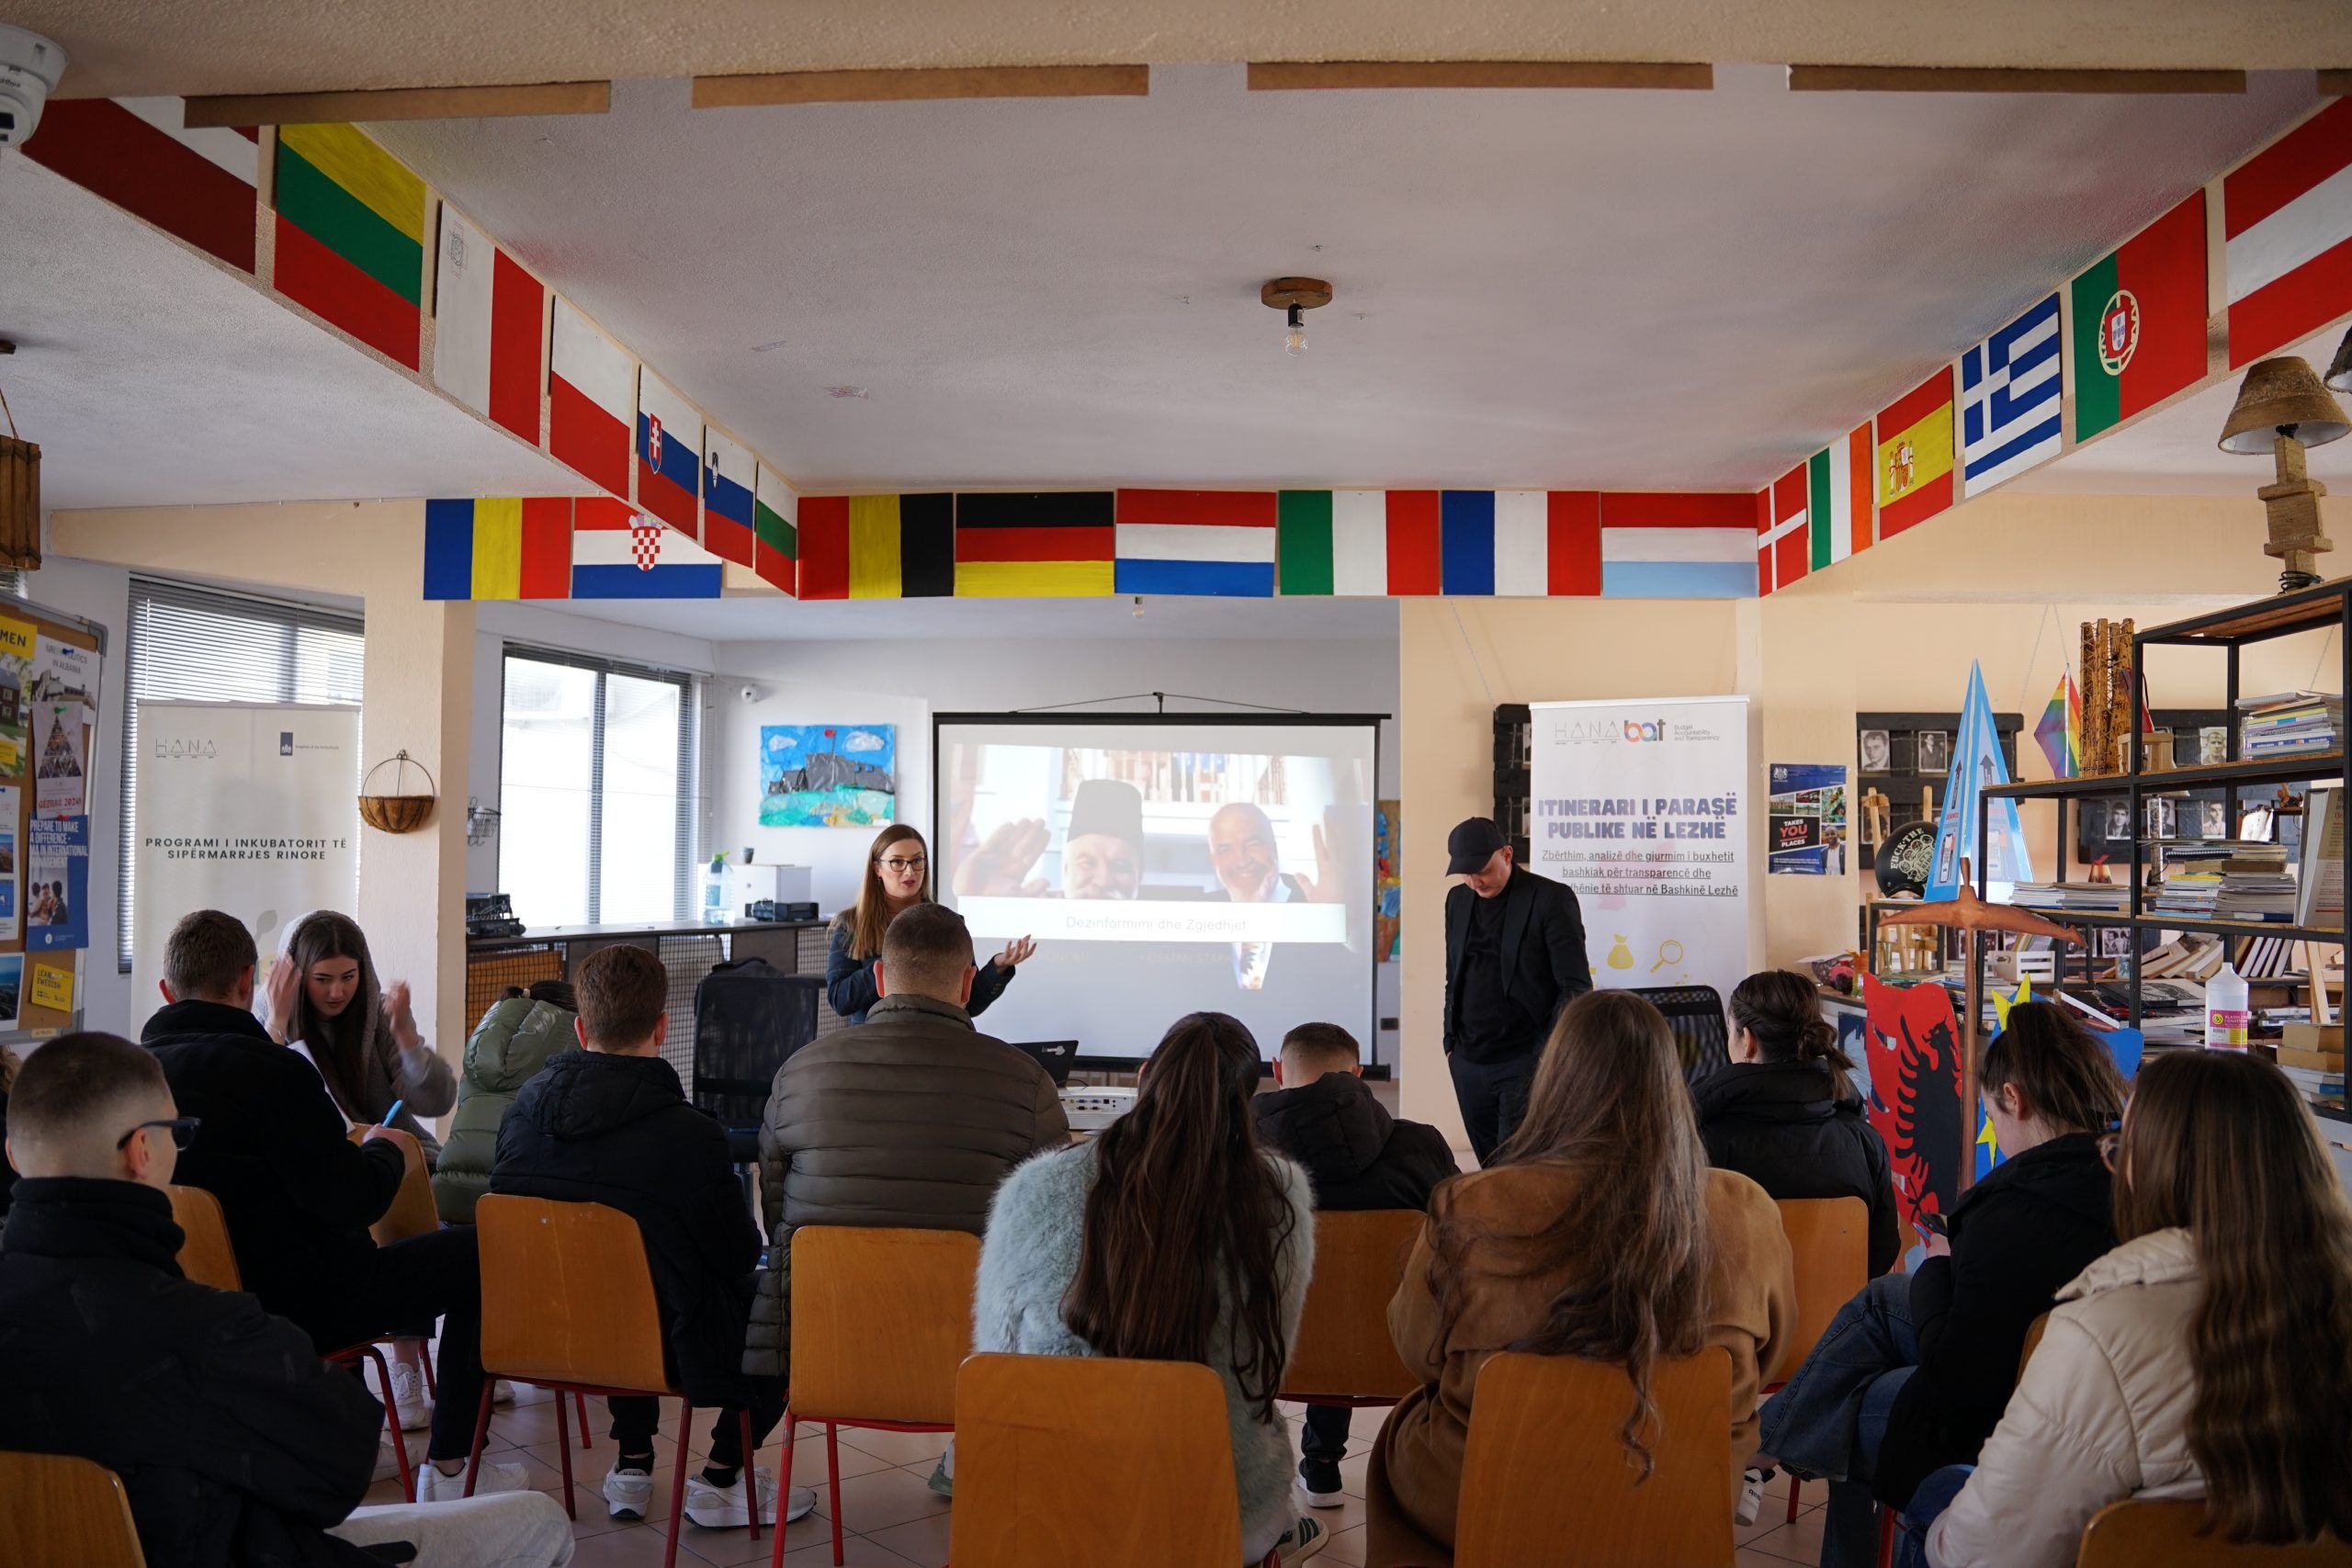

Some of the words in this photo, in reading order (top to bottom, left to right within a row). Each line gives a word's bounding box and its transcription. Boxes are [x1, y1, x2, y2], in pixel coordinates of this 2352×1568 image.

[1538, 798, 1635, 817] ITINERARI
[1643, 798, 1648, 816] I
[30, 819, 54, 832] PREPARE
[55, 821, 62, 832] TO
[62, 821, 80, 834] MAKE
[1548, 822, 1625, 840] PUBLIKE
[1632, 816, 1657, 840] NË
[1664, 816, 1725, 840] LEZHË
[1783, 818, 1804, 827] TAKES
[1780, 824, 1807, 838] YOU
[35, 833, 68, 844] DIFFERENCE
[145, 838, 219, 848] PROGRAMI
[225, 838, 229, 848] I
[235, 838, 326, 848] INKUBATORIT
[333, 838, 346, 849] TË
[1781, 839, 1805, 848] PLACES
[167, 848, 271, 860] SIPËRMARRJES
[277, 851, 325, 860] RINORE
[1589, 851, 1623, 861] analizë
[1624, 851, 1644, 861] dhe
[1645, 851, 1685, 863] gjurmim
[1692, 851, 1735, 862] buxhetit
[1562, 866, 1604, 877] bashkiak
[1625, 867, 1690, 879] transparencë
[1692, 867, 1712, 878] dhe
[1613, 883, 1645, 894] shtuar
[1661, 884, 1706, 895] Bashkinë
[1708, 886, 1738, 896] Lezhë
[1066, 917, 1153, 931] Dezinformimi
[1158, 918, 1182, 931] dhe
[1186, 919, 1248, 933] Zgjedhjet
